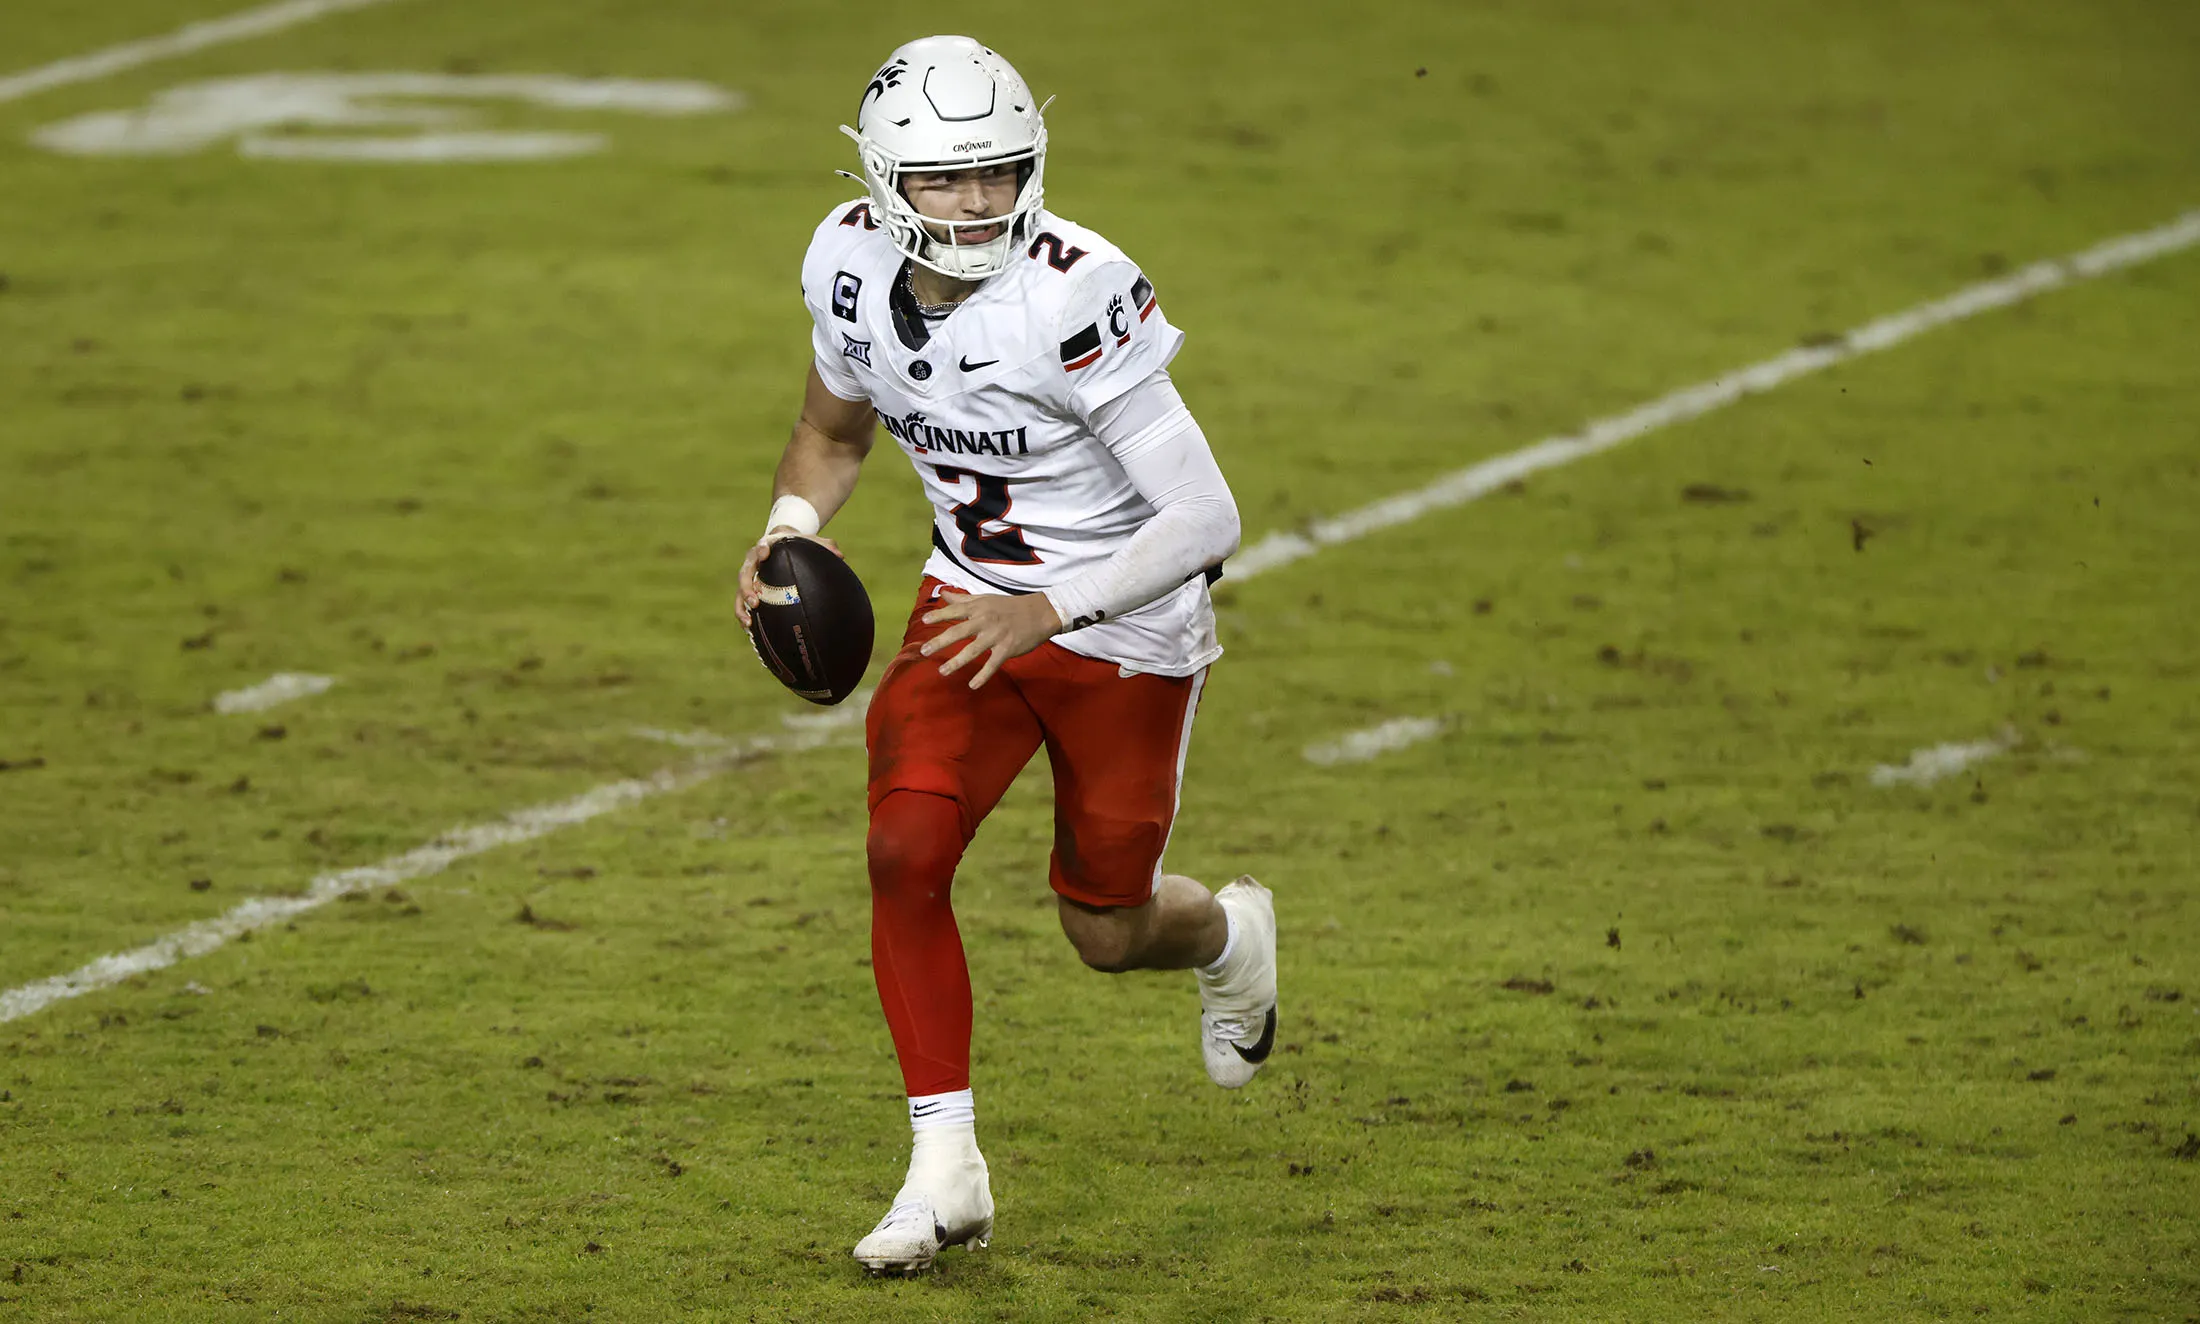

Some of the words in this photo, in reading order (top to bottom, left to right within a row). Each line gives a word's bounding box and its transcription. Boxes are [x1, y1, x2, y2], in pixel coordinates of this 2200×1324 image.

[953, 141, 992, 152] CINCINNATI
[1028, 231, 1090, 274] 2
[834, 274, 860, 310] C
[914, 362, 925, 371] JK
[915, 370, 927, 379] 58
[935, 464, 1045, 565] 2
